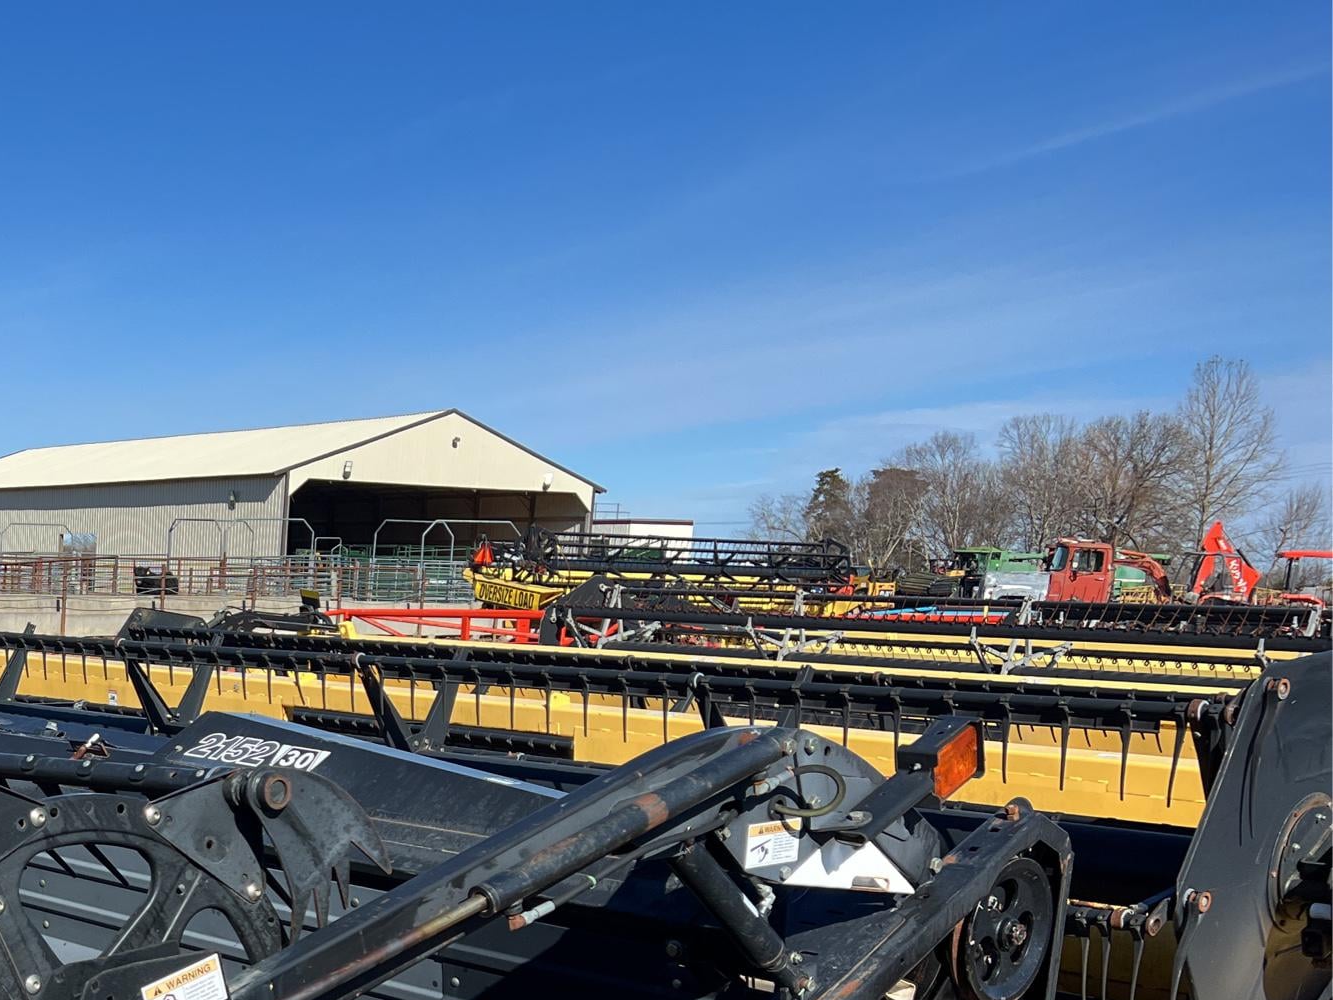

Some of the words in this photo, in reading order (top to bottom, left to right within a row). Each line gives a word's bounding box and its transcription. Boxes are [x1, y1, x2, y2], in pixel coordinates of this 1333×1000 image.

[479, 583, 514, 605] OVERSIZE
[514, 591, 535, 609] LOAD
[183, 732, 281, 767] 2152
[278, 749, 312, 769] 30
[166, 963, 211, 990] WARNING
